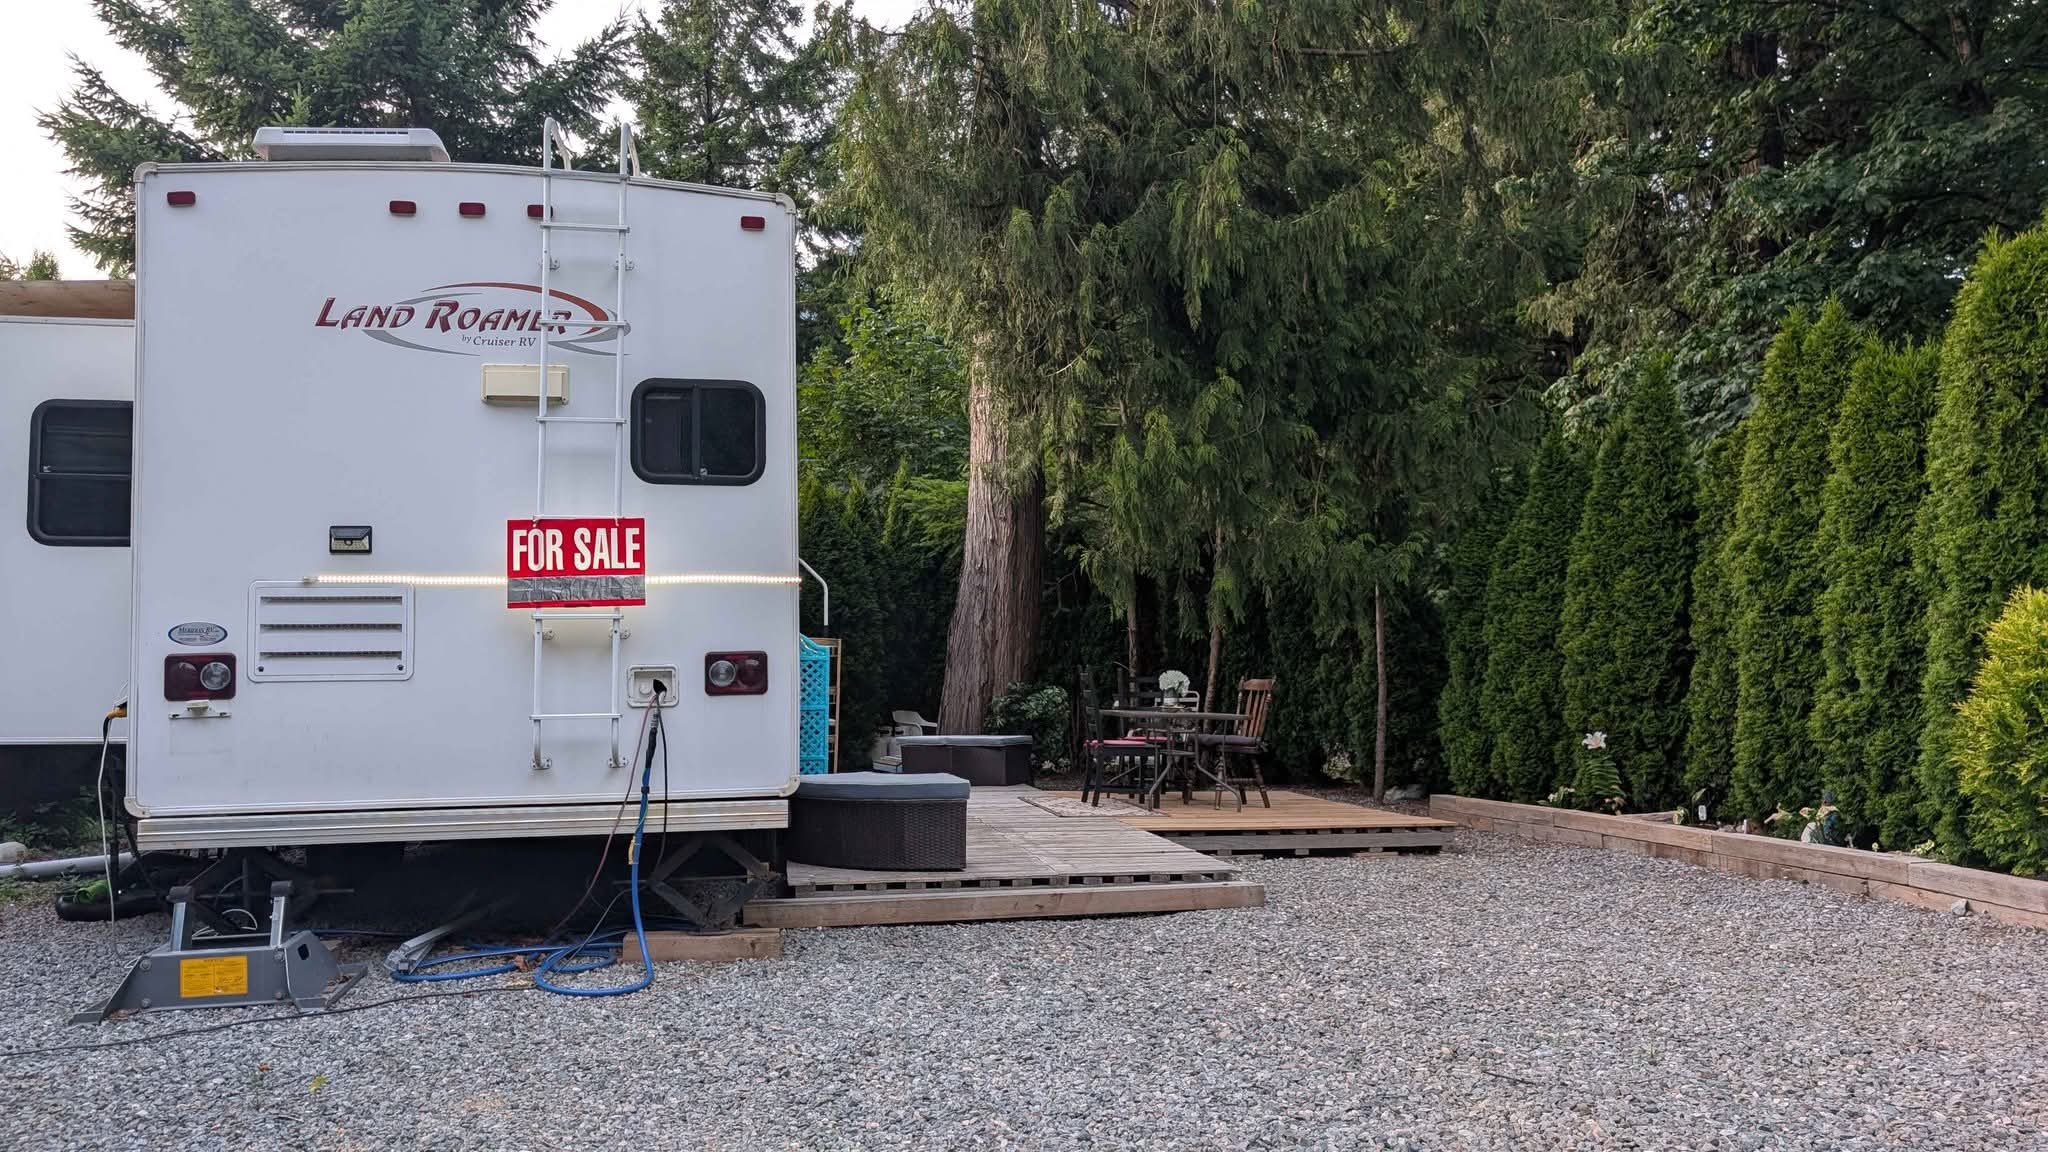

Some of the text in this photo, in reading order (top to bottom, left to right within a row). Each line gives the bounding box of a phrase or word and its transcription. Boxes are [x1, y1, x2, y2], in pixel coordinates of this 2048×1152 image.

[315, 297, 415, 329] LAND
[461, 335, 536, 346] by Cruiser RV
[512, 527, 640, 572] FOR SALE
